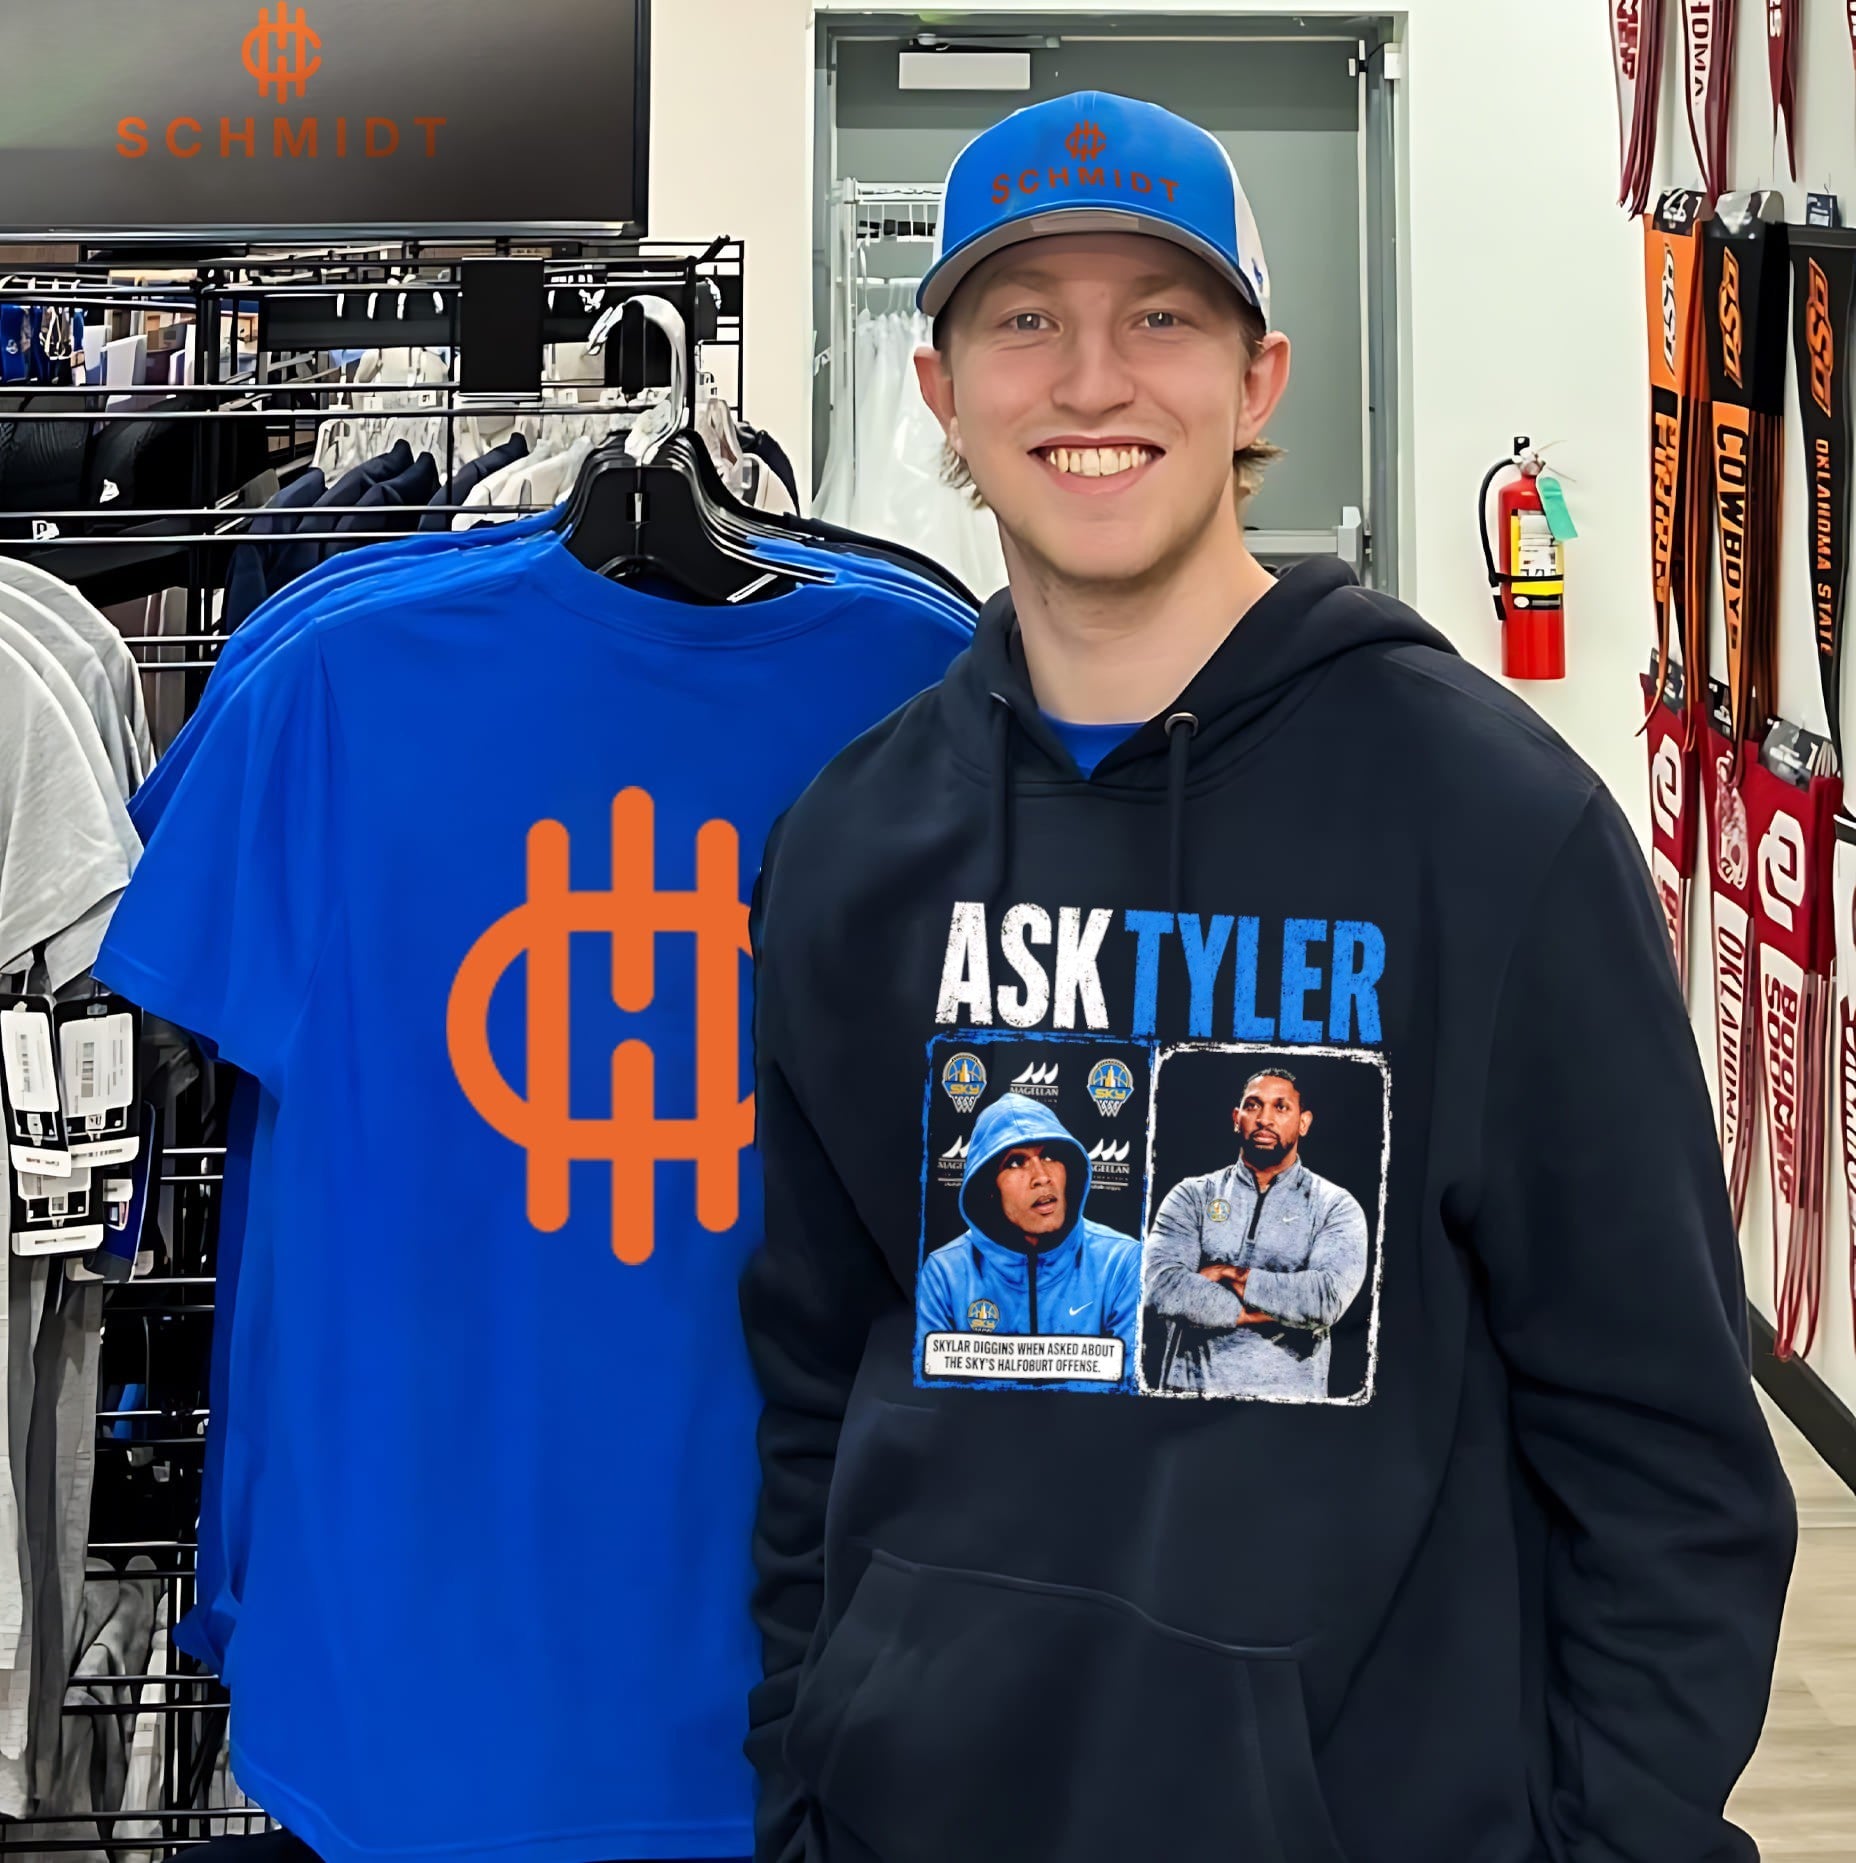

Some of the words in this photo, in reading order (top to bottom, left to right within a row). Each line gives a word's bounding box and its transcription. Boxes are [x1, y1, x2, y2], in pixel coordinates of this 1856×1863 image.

[115, 116, 447, 158] SCHMIDT
[991, 167, 1179, 204] SCHMIDT
[1815, 438, 1832, 570] OKLAHOMA
[935, 901, 1113, 1030] ASK
[1125, 909, 1386, 1044] TYLER
[949, 1083, 980, 1095] SKY
[1009, 1086, 1059, 1097] MAGELLAN
[1094, 1088, 1127, 1100] SKY
[933, 1339, 970, 1353] SKYLAR
[973, 1341, 1014, 1355] DIGGINS
[1017, 1342, 1045, 1355] WHEN
[1047, 1343, 1078, 1356] ASKED
[1081, 1345, 1115, 1358] ABOUT
[944, 1356, 962, 1369] THE
[965, 1357, 995, 1371] SKY'S
[1056, 1360, 1101, 1373] OFFENSE.
